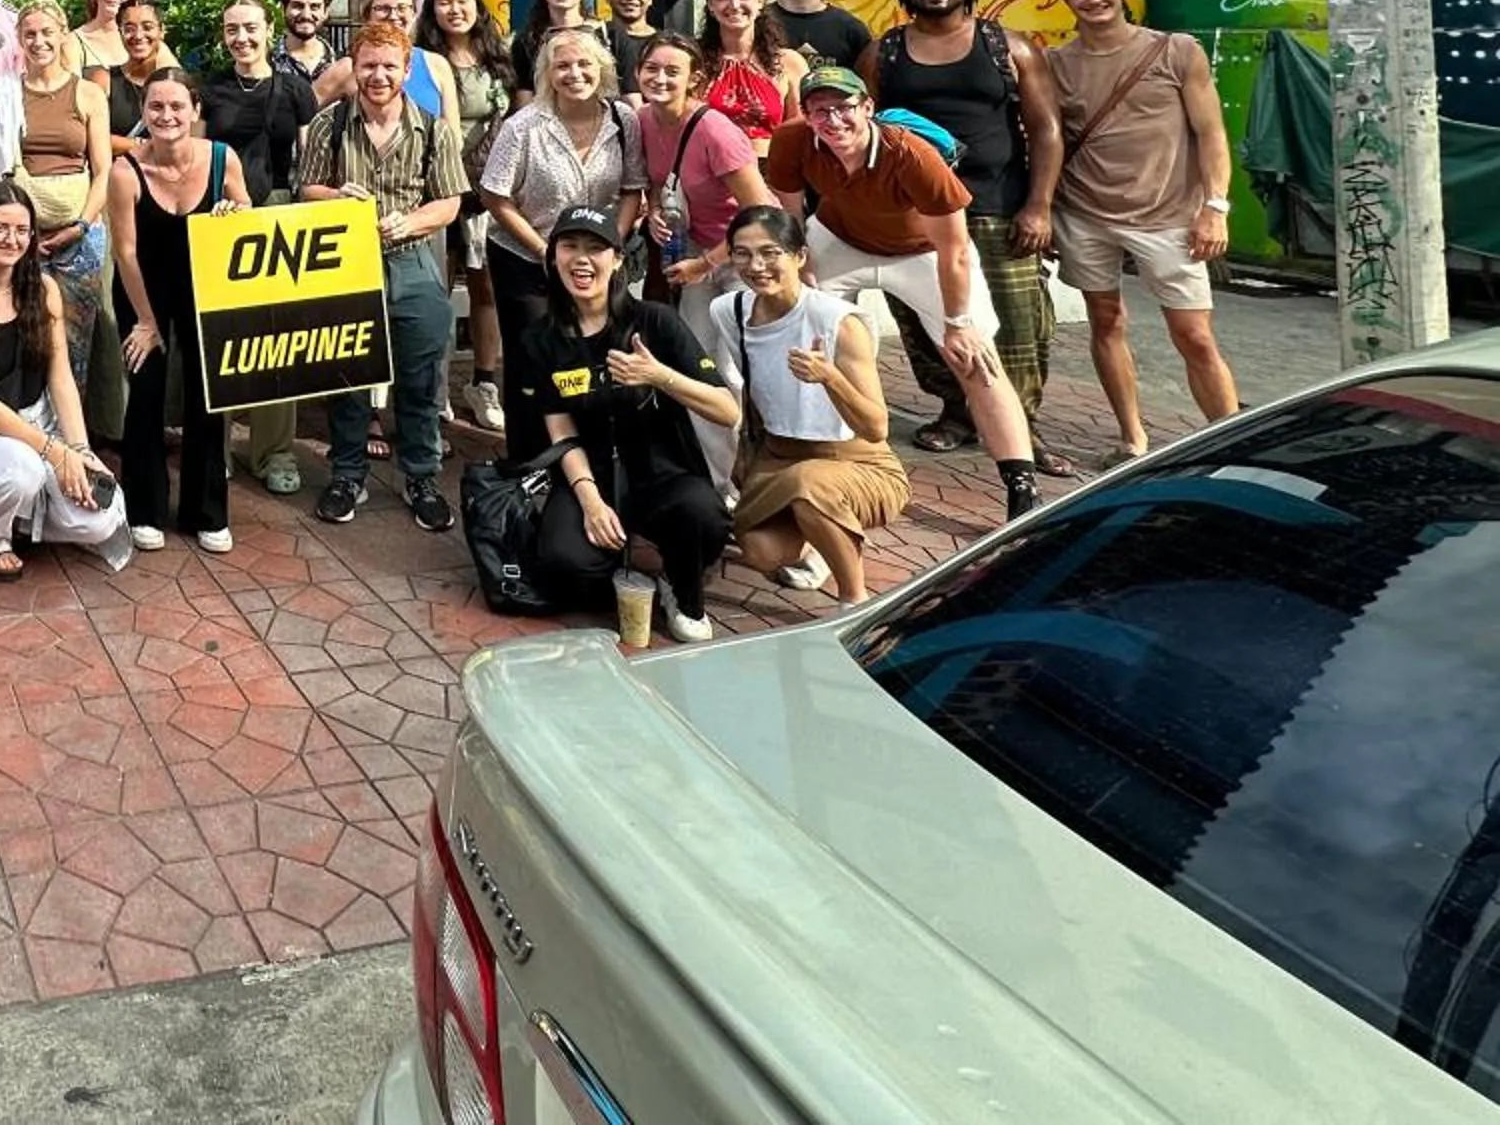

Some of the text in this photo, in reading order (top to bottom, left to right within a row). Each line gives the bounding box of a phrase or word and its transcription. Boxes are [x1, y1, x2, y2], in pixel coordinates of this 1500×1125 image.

[571, 207, 607, 225] ONE
[227, 220, 348, 286] ONE
[219, 321, 375, 376] LUMPINEE
